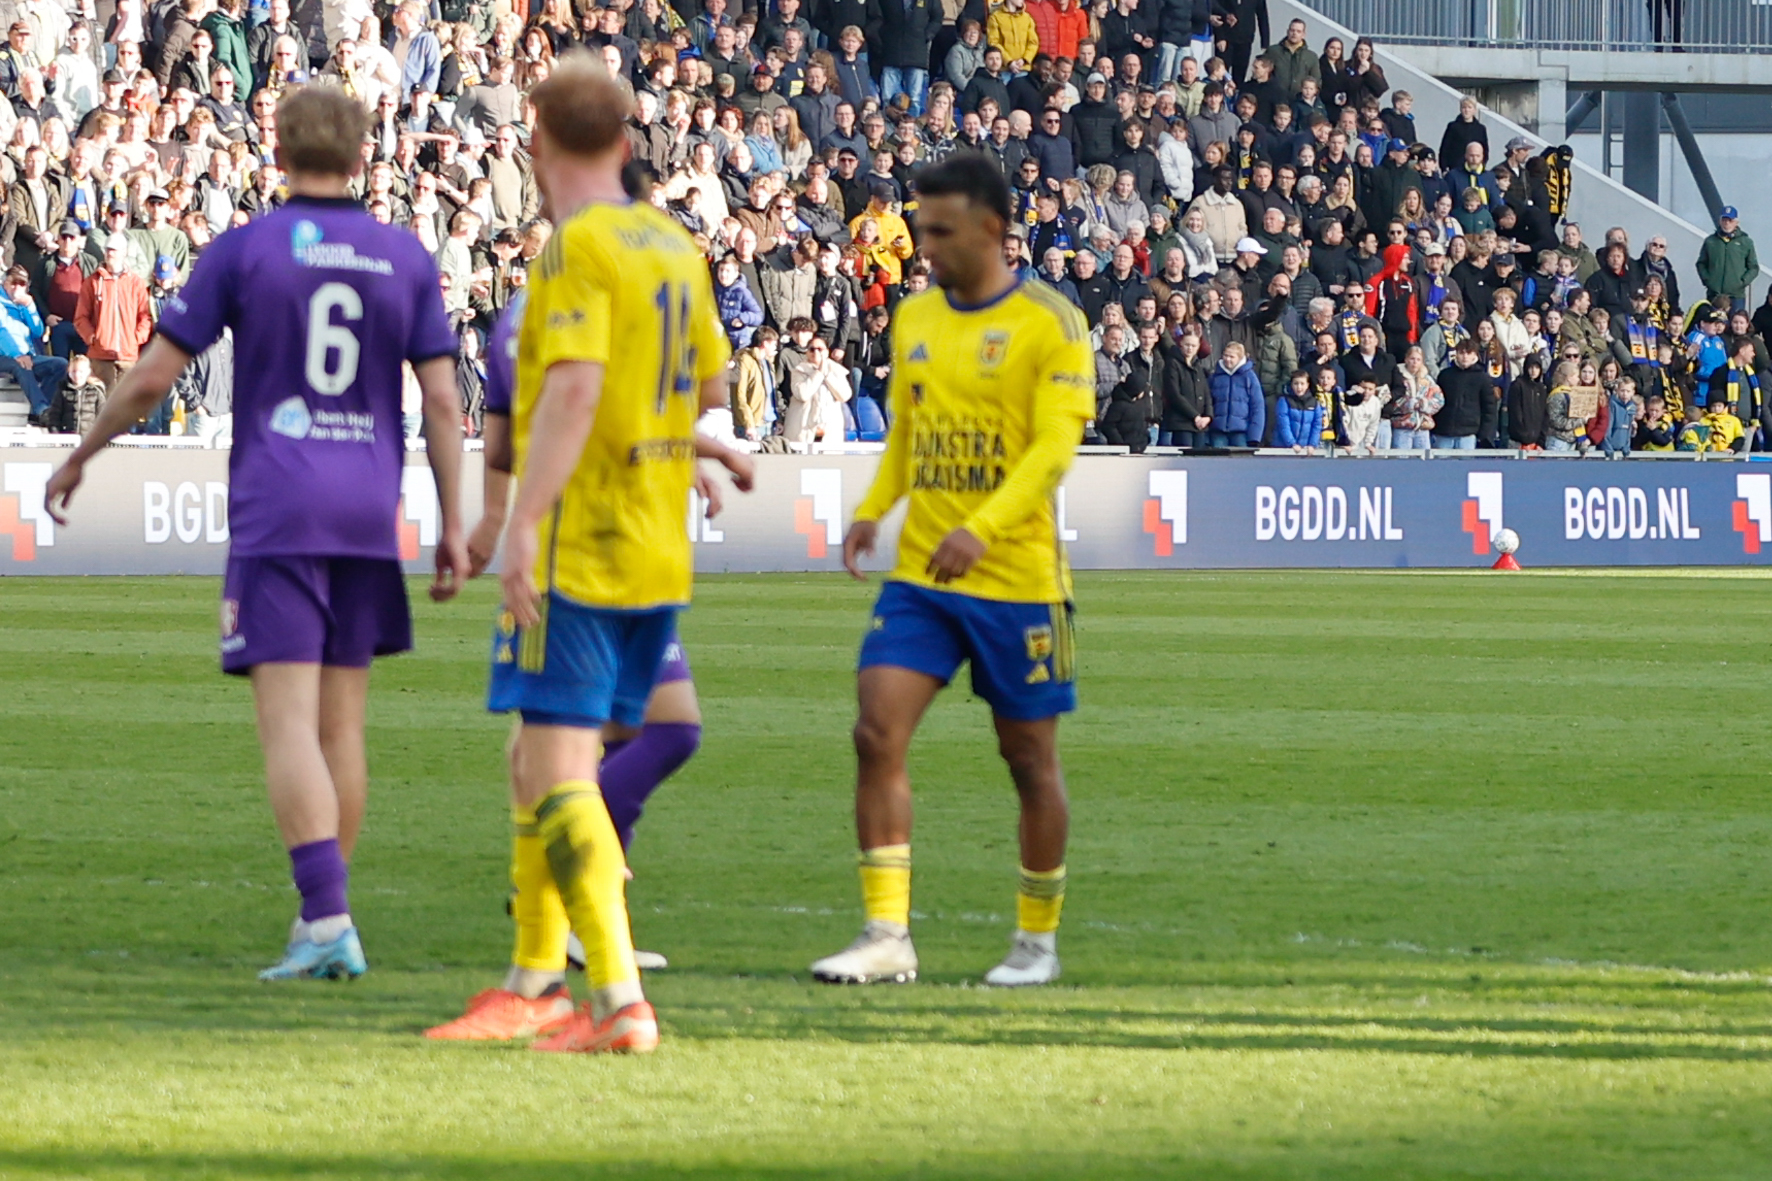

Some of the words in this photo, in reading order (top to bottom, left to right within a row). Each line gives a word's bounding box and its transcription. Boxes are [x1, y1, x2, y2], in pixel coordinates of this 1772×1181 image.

[305, 281, 364, 397] 6
[1255, 485, 1403, 540] BGDD.NL
[1564, 486, 1701, 540] BGDD.NL
